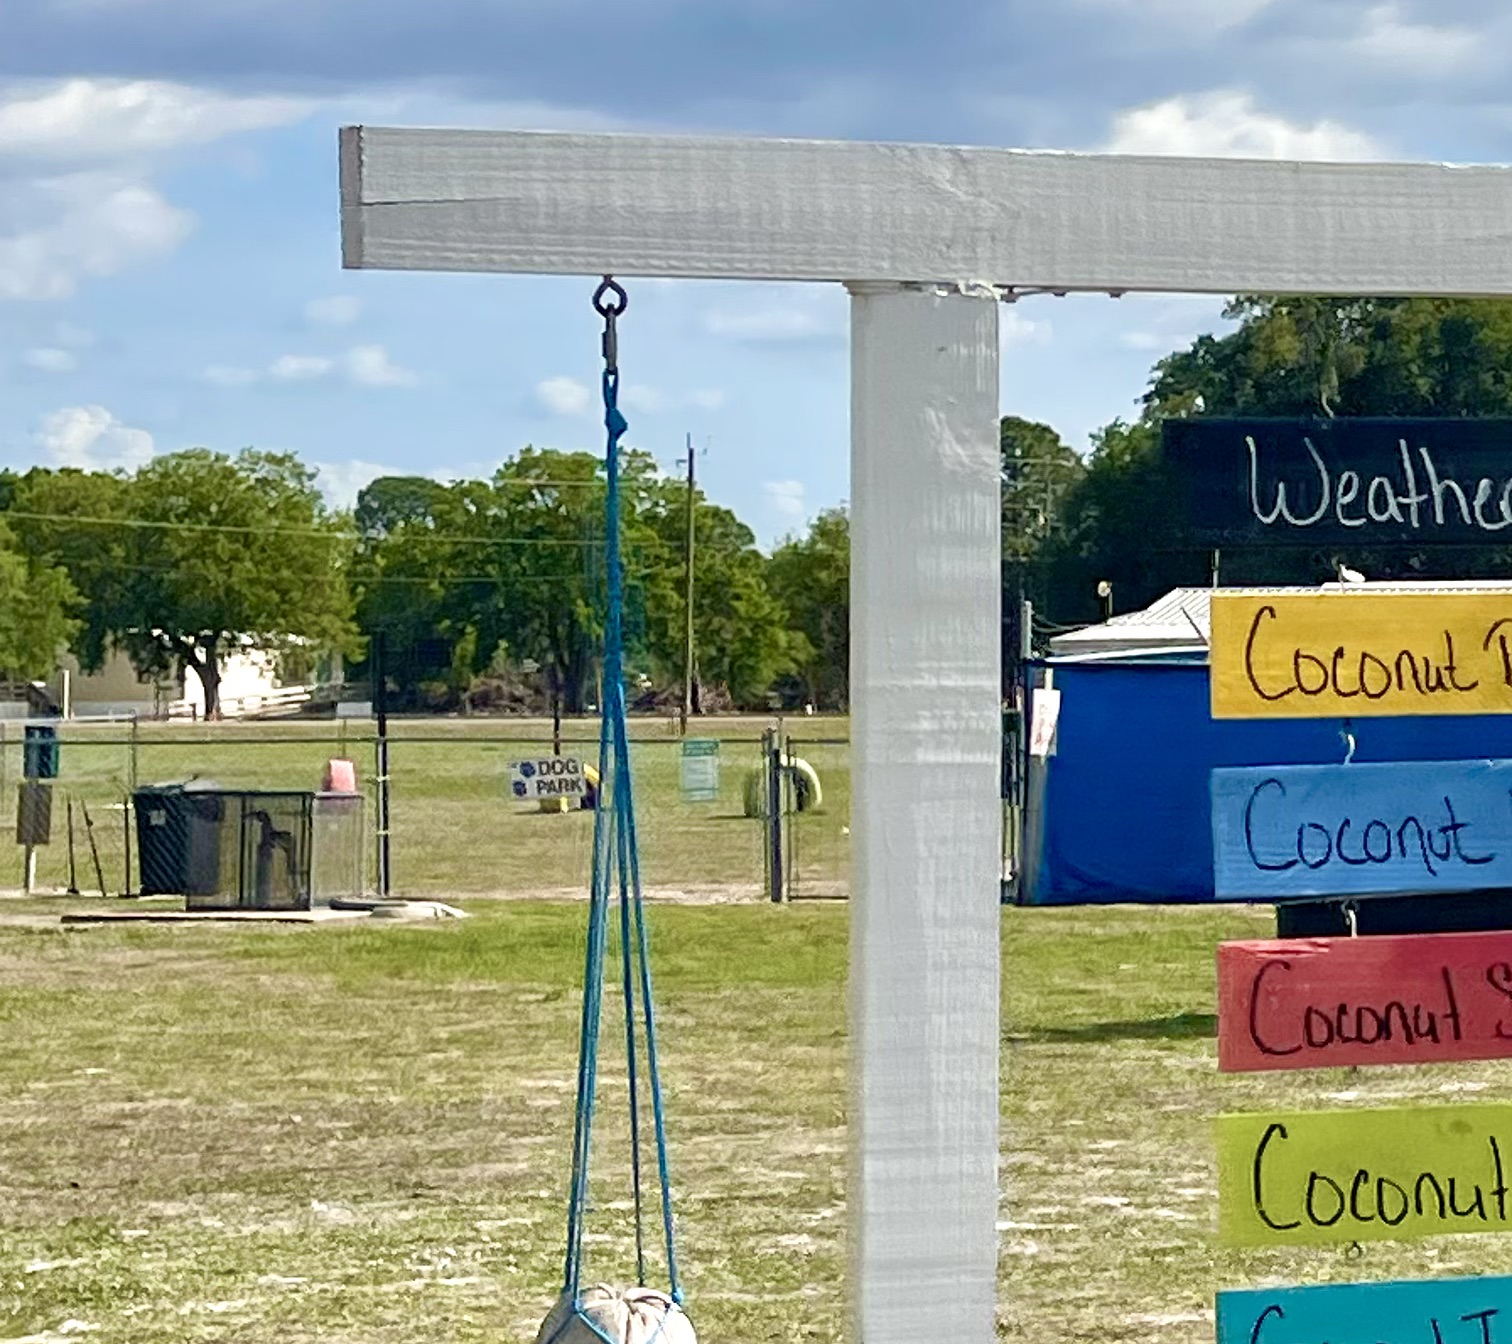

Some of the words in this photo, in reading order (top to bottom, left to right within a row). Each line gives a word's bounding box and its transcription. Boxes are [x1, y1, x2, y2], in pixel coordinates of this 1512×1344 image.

[1245, 606, 1478, 702] Coconut
[536, 777, 583, 795] PARK
[538, 758, 579, 776] DOG
[1245, 778, 1495, 877] Coconut
[1250, 959, 1461, 1056] Coconut
[1253, 1123, 1509, 1229] Coconut
